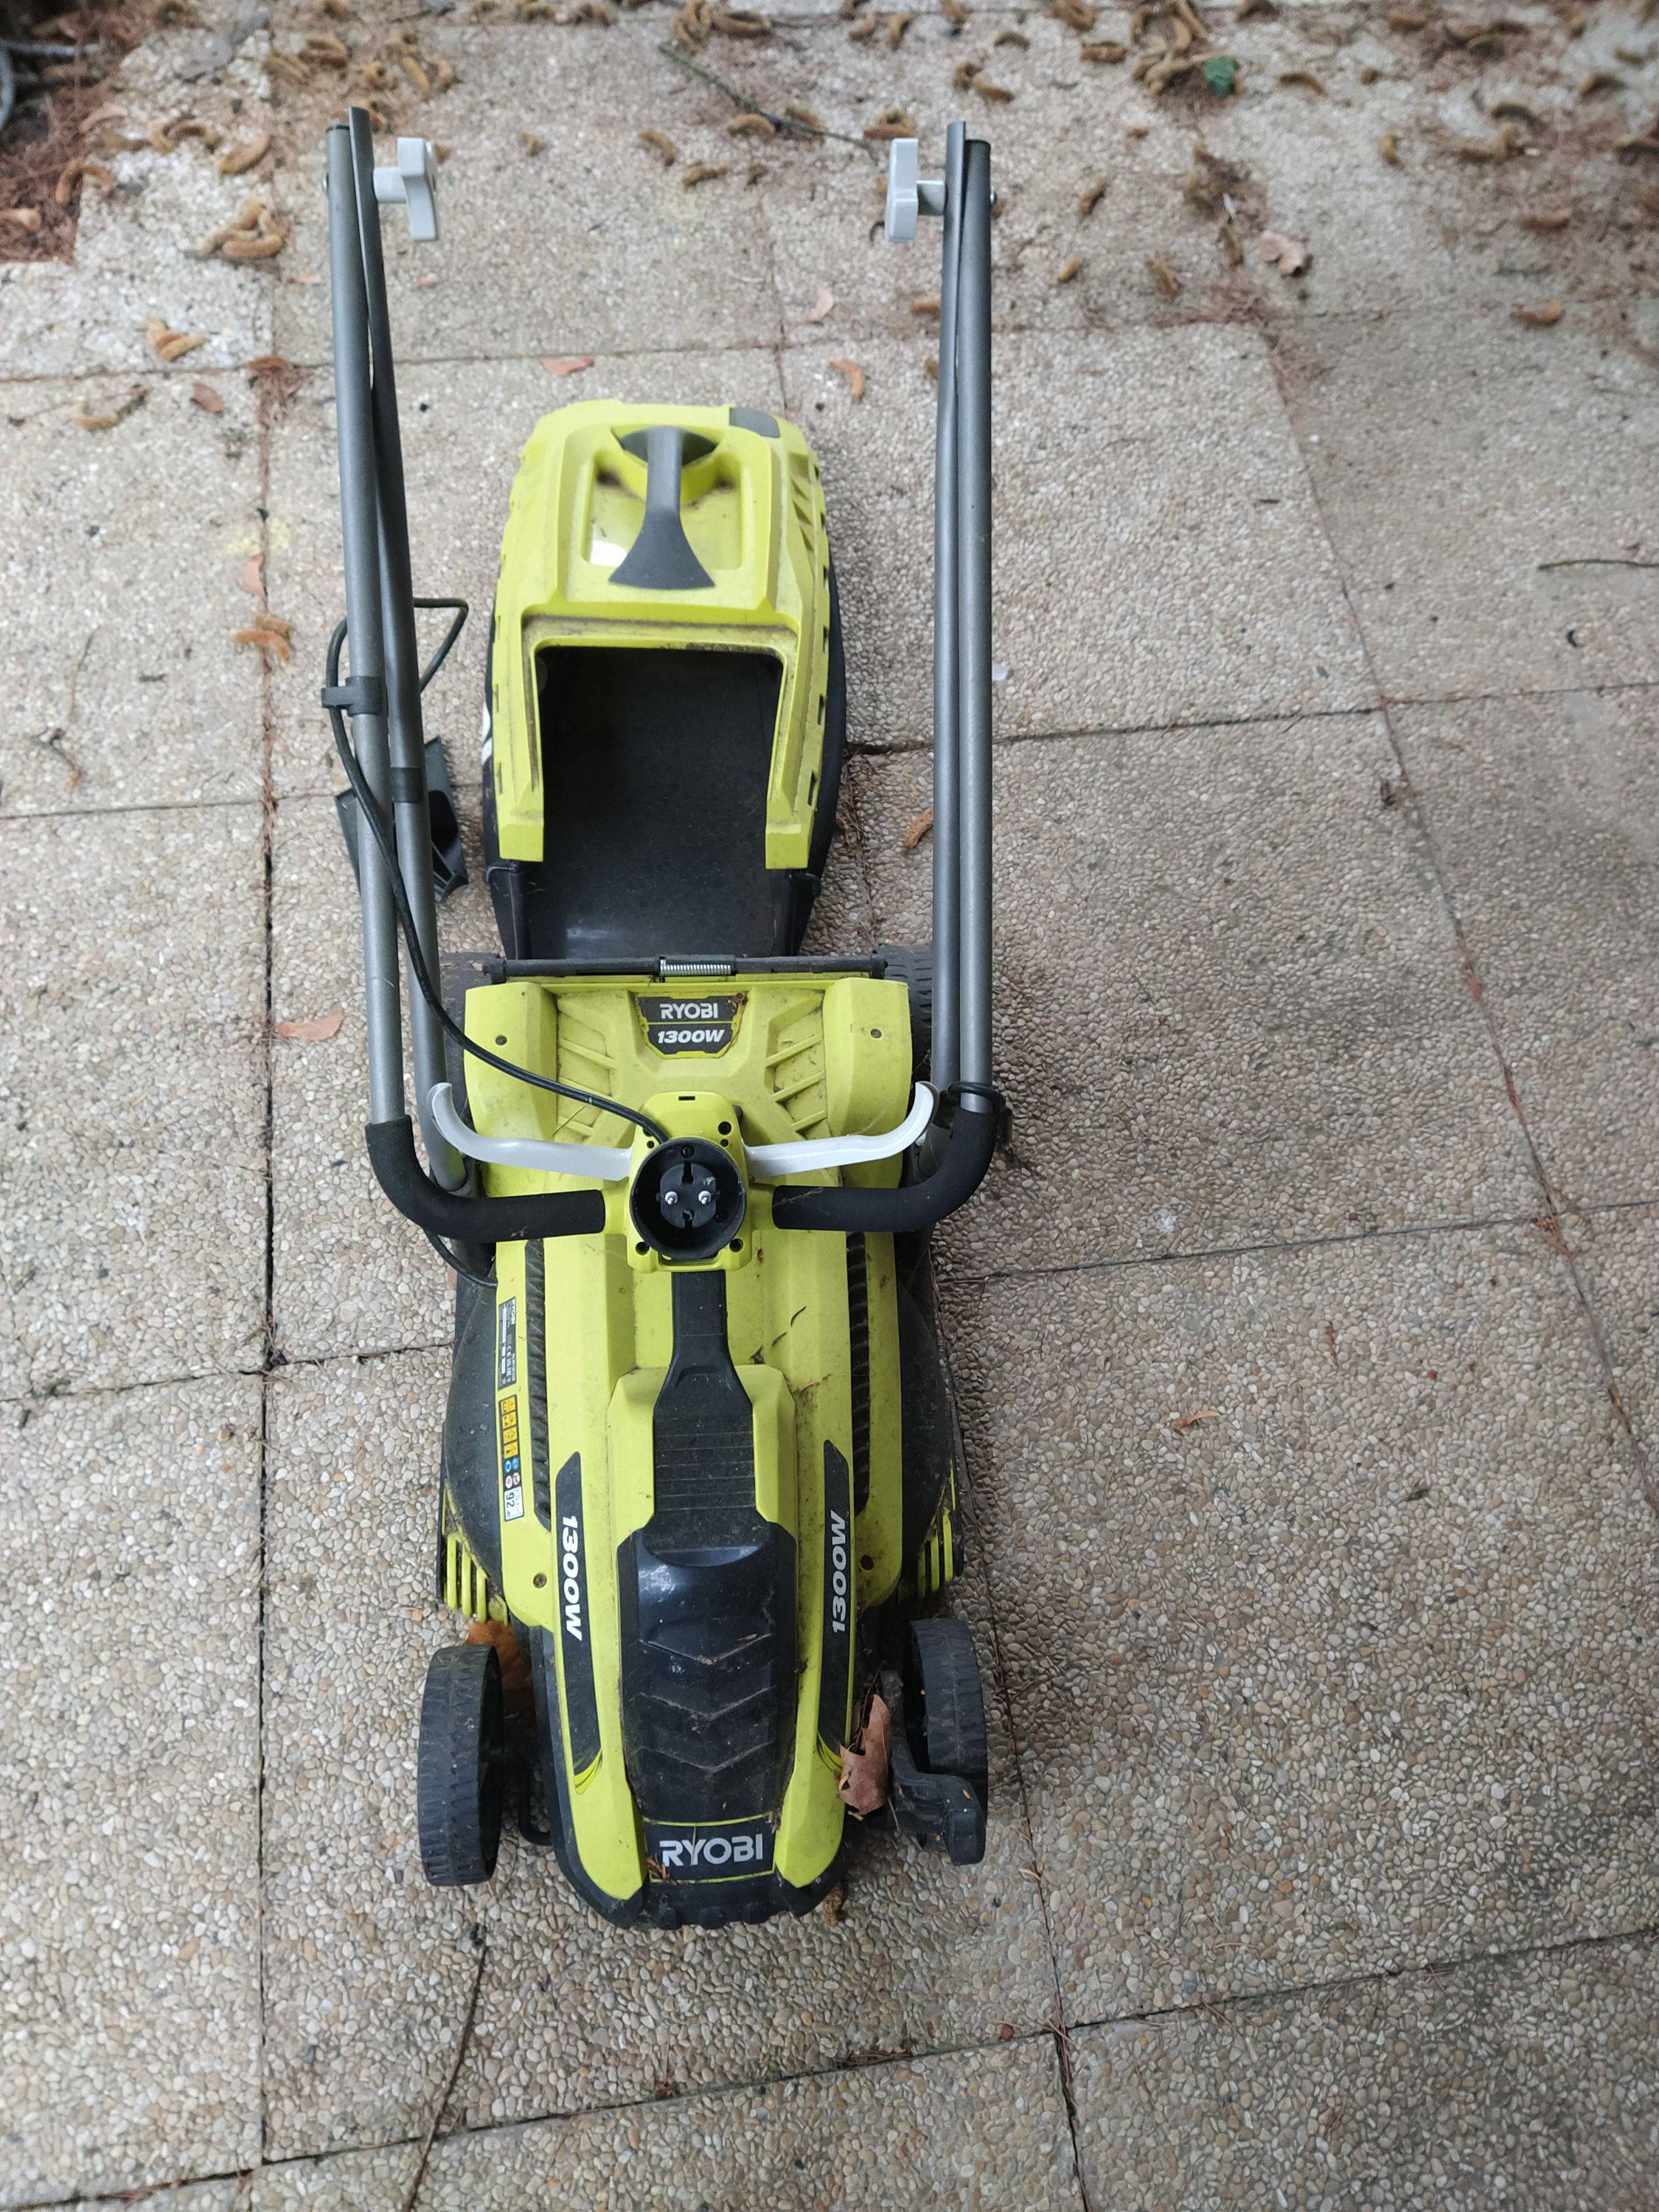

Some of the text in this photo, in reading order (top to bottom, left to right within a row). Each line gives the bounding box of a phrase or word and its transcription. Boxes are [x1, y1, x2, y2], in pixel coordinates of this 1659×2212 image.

[659, 1003, 718, 1019] RYOBI
[658, 1029, 725, 1043] 1300W
[506, 1492, 515, 1509] 92
[562, 1515, 582, 1641] 1300W
[830, 1509, 846, 1633] 1300W
[659, 1833, 763, 1868] RYOBI
